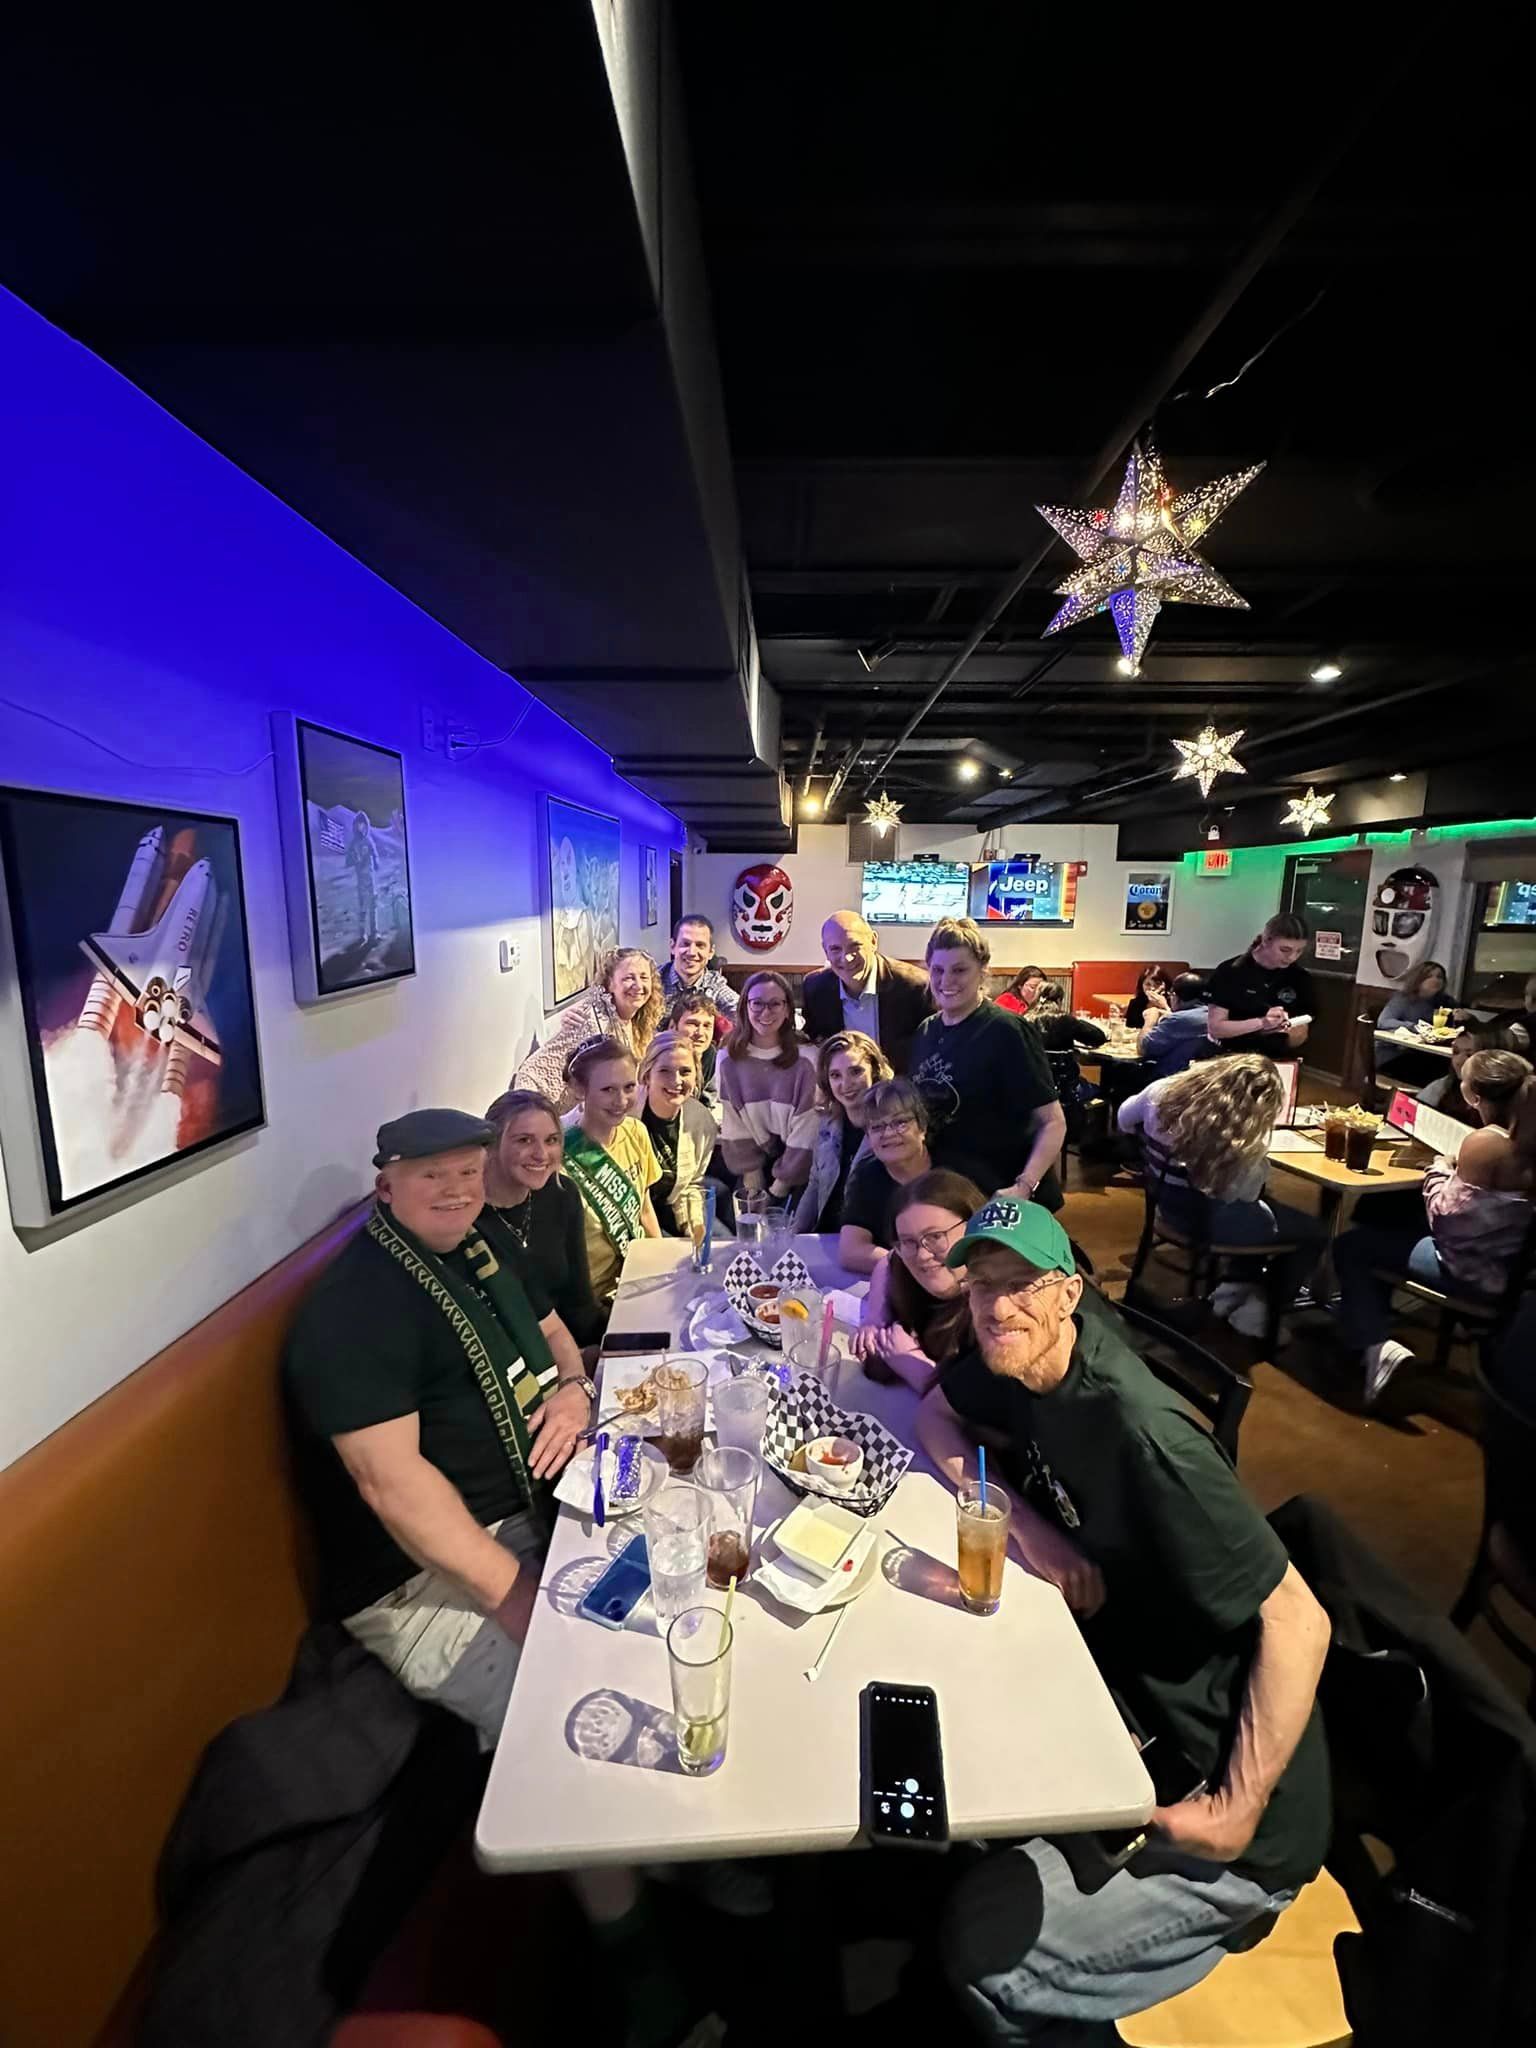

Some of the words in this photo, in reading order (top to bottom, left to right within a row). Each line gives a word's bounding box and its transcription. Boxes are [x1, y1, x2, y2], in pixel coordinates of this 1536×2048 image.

[999, 875, 1048, 895] Jeep
[178, 907, 198, 952] RETRO
[594, 1162, 628, 1203] MISS
